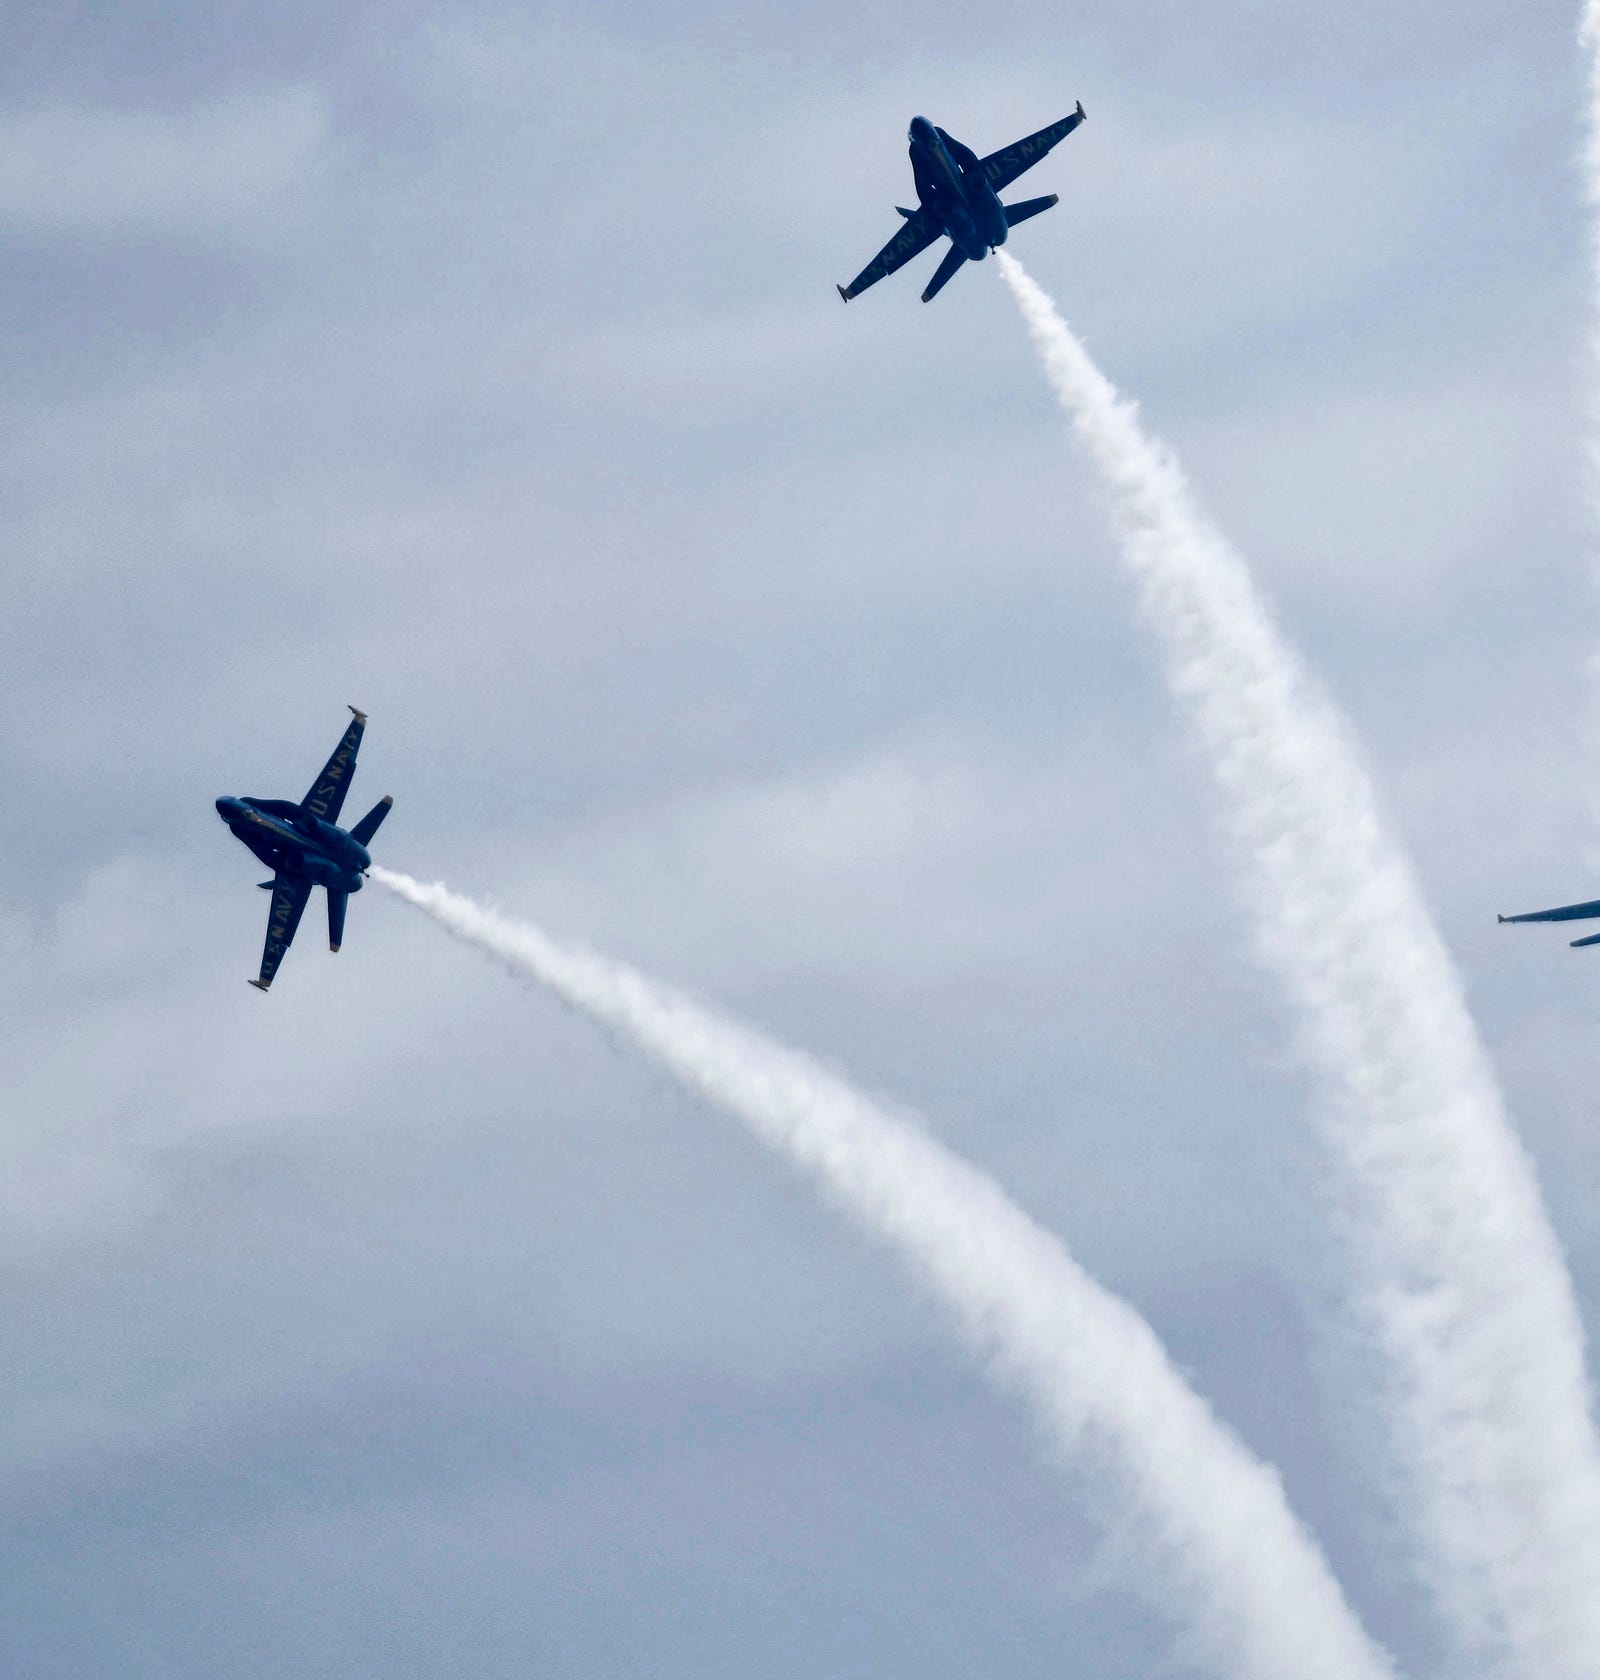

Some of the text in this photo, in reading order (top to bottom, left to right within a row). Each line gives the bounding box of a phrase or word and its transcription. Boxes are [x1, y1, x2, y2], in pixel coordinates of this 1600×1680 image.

[1019, 122, 1067, 158] NAVY
[880, 215, 925, 265] NAVY
[326, 728, 358, 780] NAVY
[270, 877, 297, 939] NAVY
